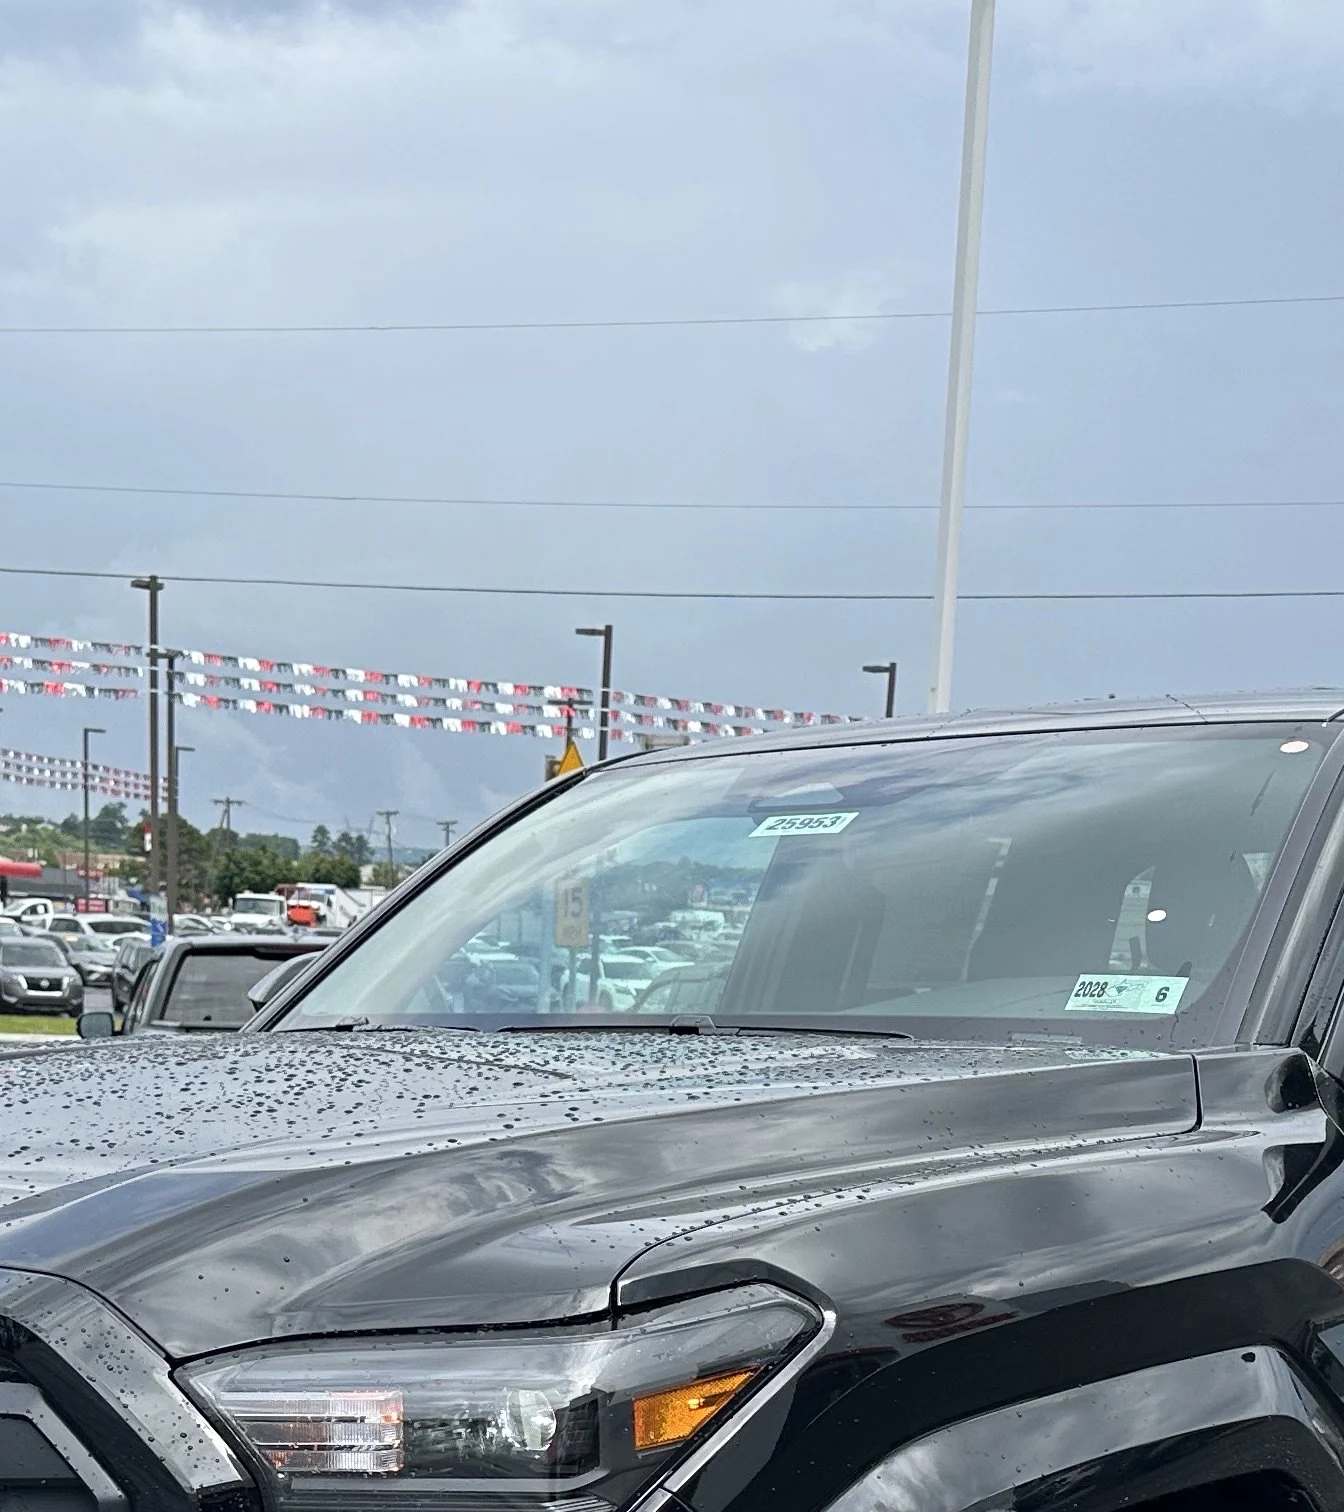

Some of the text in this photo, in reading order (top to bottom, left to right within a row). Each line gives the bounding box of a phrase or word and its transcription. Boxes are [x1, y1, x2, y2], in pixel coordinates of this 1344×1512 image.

[765, 816, 842, 830] 25953
[1074, 981, 1170, 1003] 2028 6
